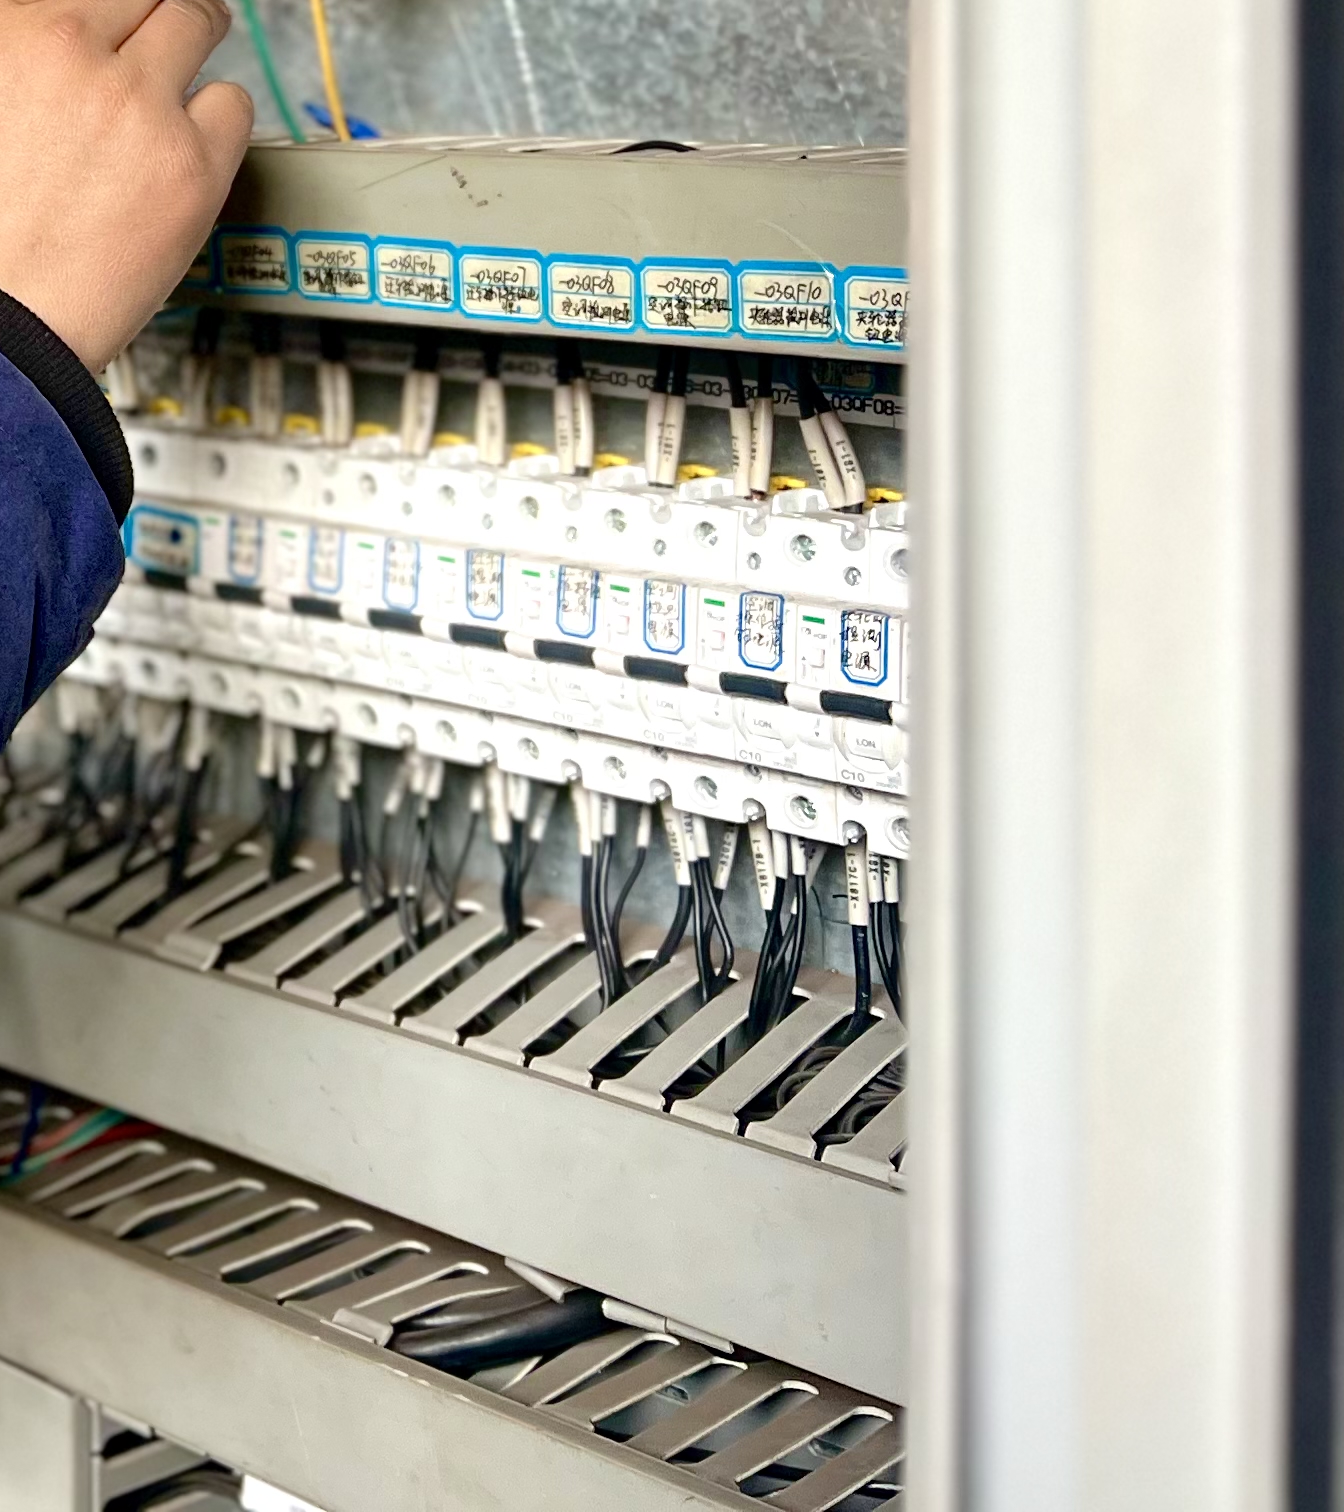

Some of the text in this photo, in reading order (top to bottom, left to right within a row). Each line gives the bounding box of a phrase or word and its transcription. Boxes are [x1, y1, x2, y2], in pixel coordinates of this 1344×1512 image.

[643, 728, 664, 742] C10
[739, 749, 761, 763] C10
[841, 769, 865, 783] C10
